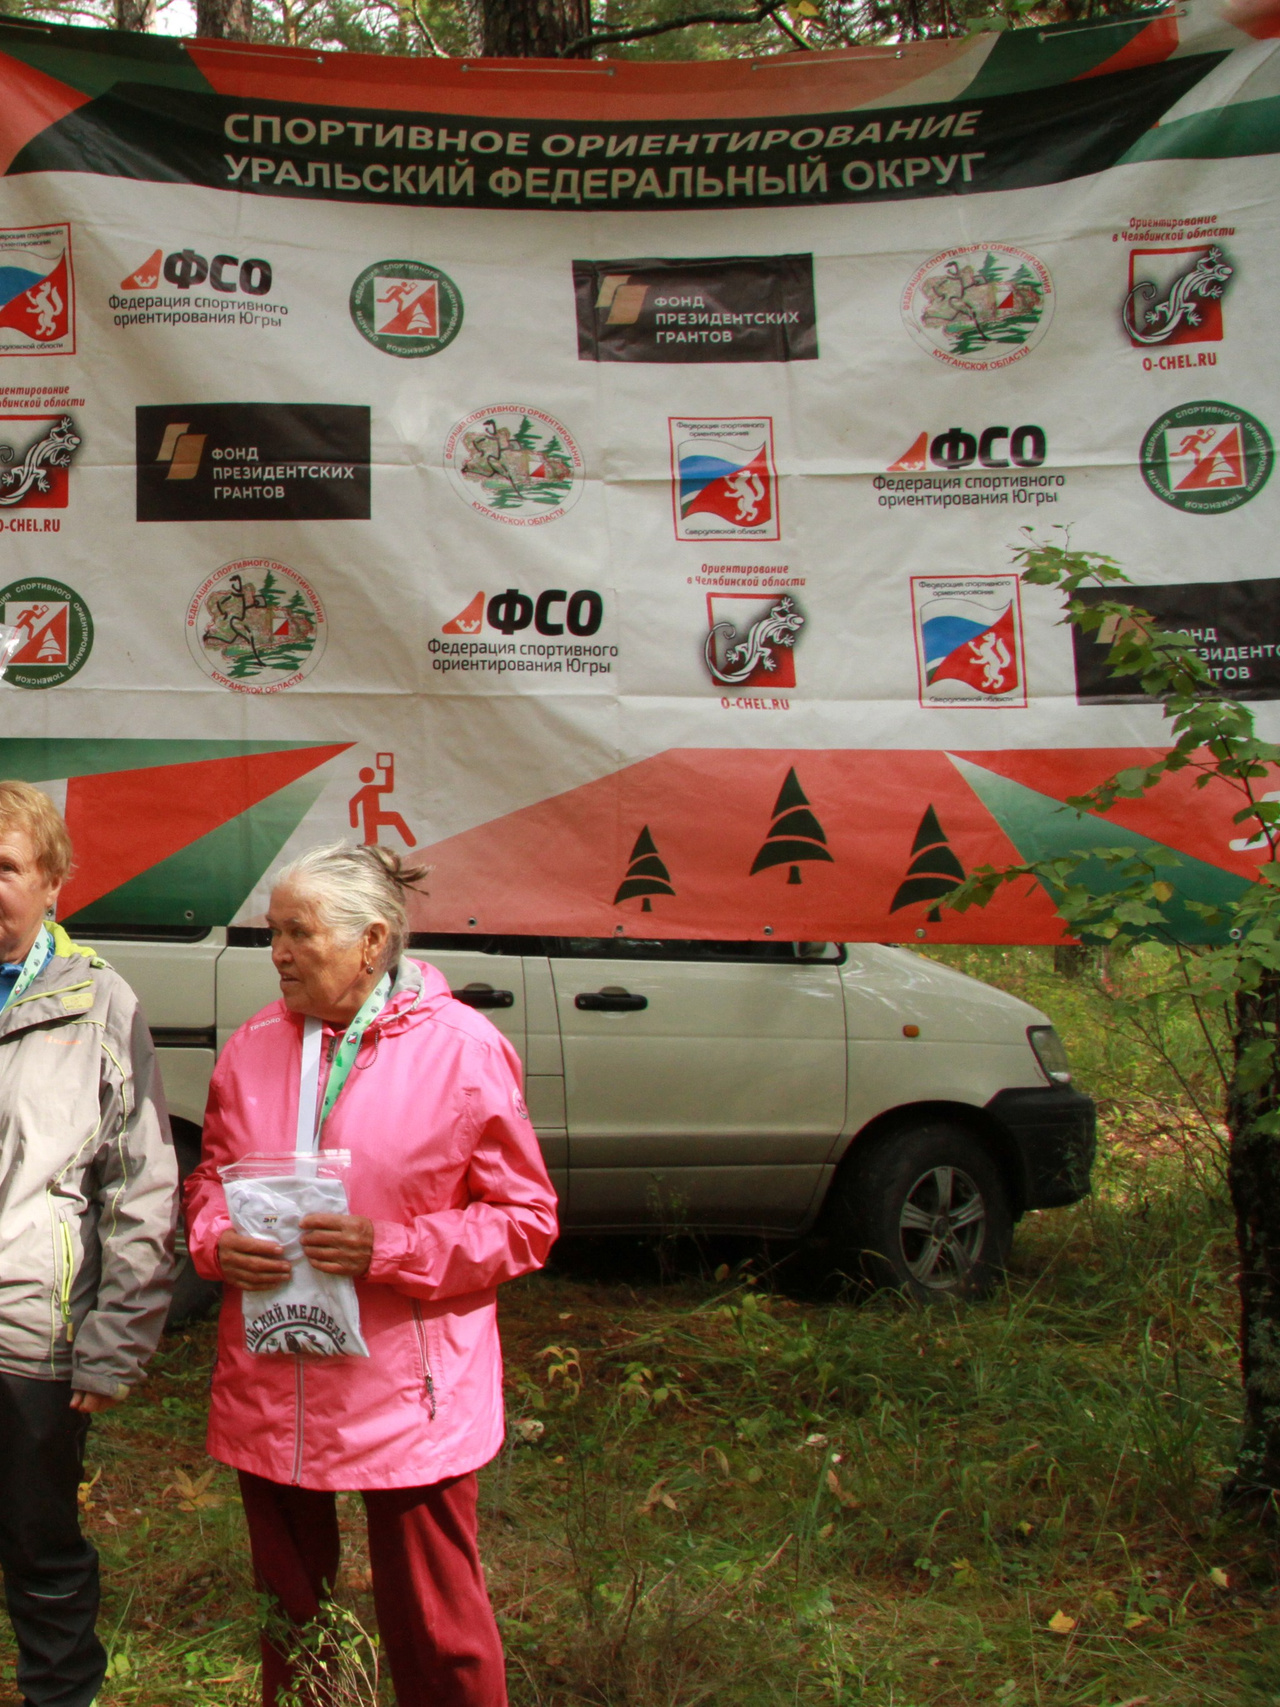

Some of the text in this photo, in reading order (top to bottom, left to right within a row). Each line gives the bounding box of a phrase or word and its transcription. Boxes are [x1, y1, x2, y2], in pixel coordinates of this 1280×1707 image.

[224, 110, 983, 158] СПОРТИВНОЕ ОРИЕНТИРОВАНИЕ
[223, 152, 987, 204] УРАЛЬСКИЙ ФЕДЕРАЛЬНЫЙ ОКРУГ
[1130, 214, 1217, 230] Ориентирование
[1112, 227, 1235, 242] в Челябинской области
[164, 249, 272, 296] ФСО
[903, 243, 1052, 311] ФЕДЕРАЦИЯ СПОРТИВНОГО ОРИЕНТИРОВАНИЯ
[108, 294, 288, 315] Федерация спортивного
[654, 296, 705, 309] ФОНД
[114, 311, 281, 329] ориентирования Югры
[656, 311, 800, 327] ПРЕЗИДЕНТСКИХ
[656, 331, 733, 343] ГРАНТОВ
[932, 346, 1030, 370] КУРГАНСКОЙ ОБЛАСТИ
[1142, 352, 1217, 371] O-CHEL.RU
[44, 397, 85, 408] области
[1175, 406, 1241, 421] СПОРТИВНОГО
[445, 406, 582, 467] ФЕДЕРАЦИЯ СПОРТИВНОГО ОРИЕНТИРОВАНИЯ
[211, 447, 259, 461] ФОНД
[930, 425, 1047, 469] ФСО
[213, 466, 355, 480] ПРЕЗИДЕНТСКИХ
[873, 474, 1065, 492] Федерация спортивного
[214, 486, 285, 499] ГРАНТОВ
[878, 489, 1057, 509] ориентирования Югры
[472, 501, 566, 526] КУРГАНСКОЙ ОБЛАСТИ
[701, 564, 789, 576] Ориентирование
[695, 575, 759, 587] Челябинской
[762, 576, 806, 587] области
[16, 583, 71, 600] СПОРТИВНОГО
[188, 560, 324, 626] ФЕДЕРАЦИЯ СПОРТИВНОГО ОРИЕНТИРОВАНИЯ
[487, 589, 603, 637] ФСО
[68, 603, 88, 671] ОРИЕНТИРОВАНИЯ
[427, 639, 618, 659] Федерация спортивного
[433, 658, 610, 676] ориентирования Югры
[15, 672, 64, 684] ТЮМЕНСКОЙ
[211, 671, 304, 694] КУРГАНСКОЙ ОБЛАСТИ
[721, 697, 790, 710] O-CHEL.RU
[286, 1304, 347, 1345] МЕДВЕДЬ
